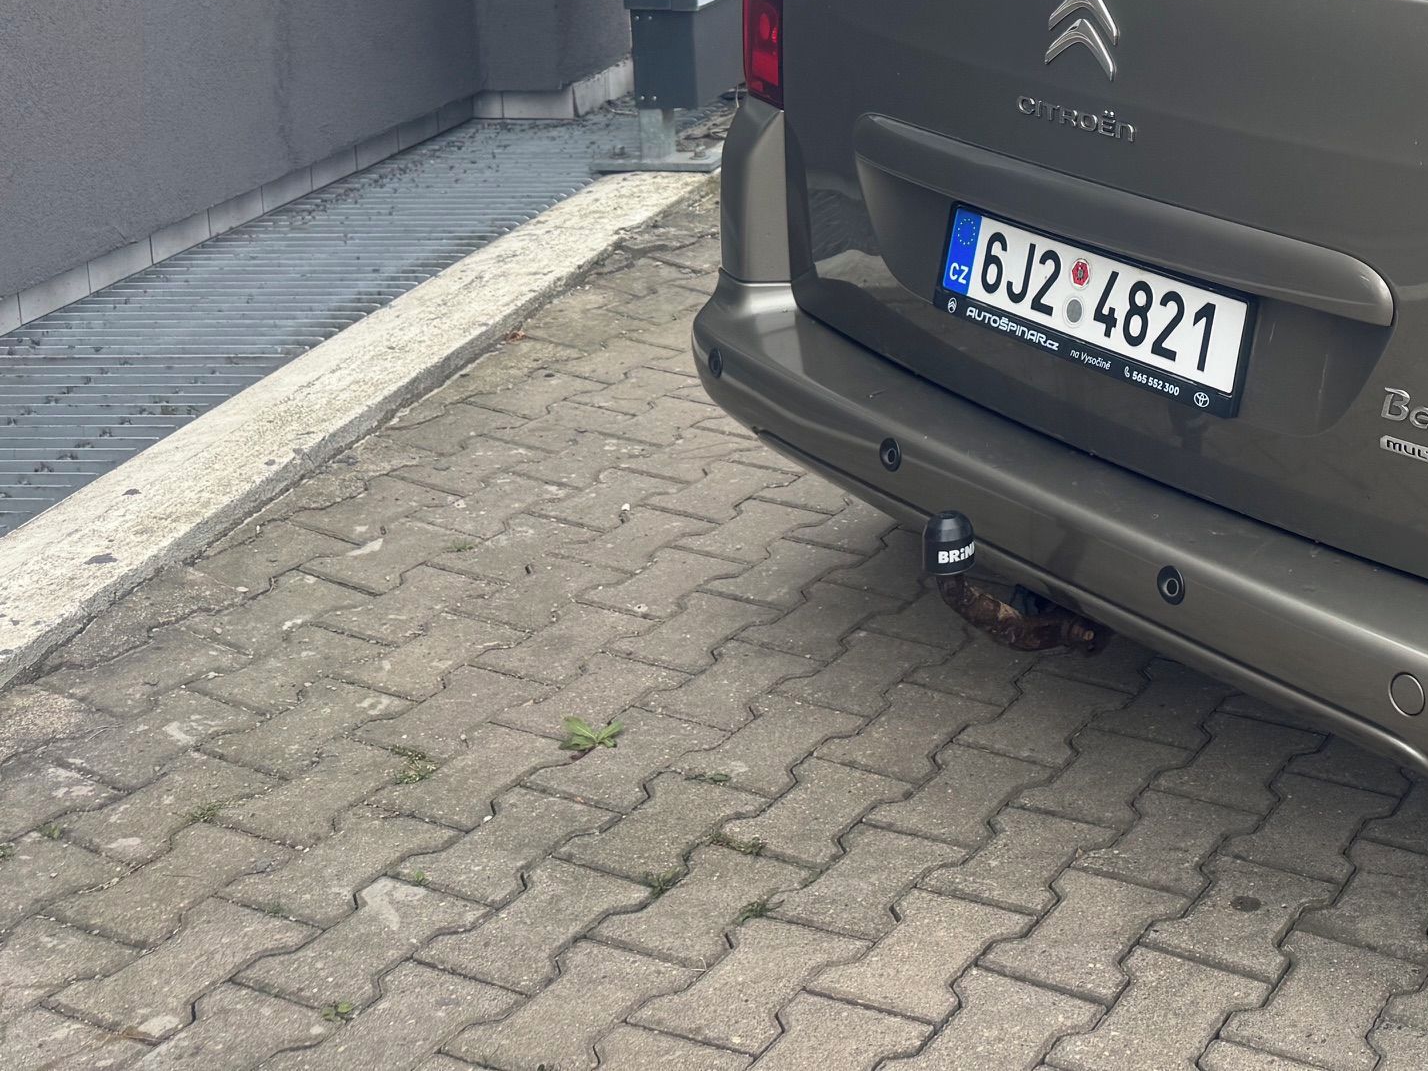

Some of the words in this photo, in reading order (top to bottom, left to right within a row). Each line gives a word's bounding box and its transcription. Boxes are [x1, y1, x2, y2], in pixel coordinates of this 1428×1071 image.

[1016, 95, 1137, 143] CITROËN
[949, 262, 968, 285] CZ
[980, 231, 1062, 317] 6J2
[1093, 270, 1217, 372] 4821
[1070, 348, 1080, 359] na
[1080, 351, 1112, 370] Vysočině
[1132, 371, 1147, 384] 565
[1148, 376, 1163, 390] 552
[1163, 381, 1180, 396] 300
